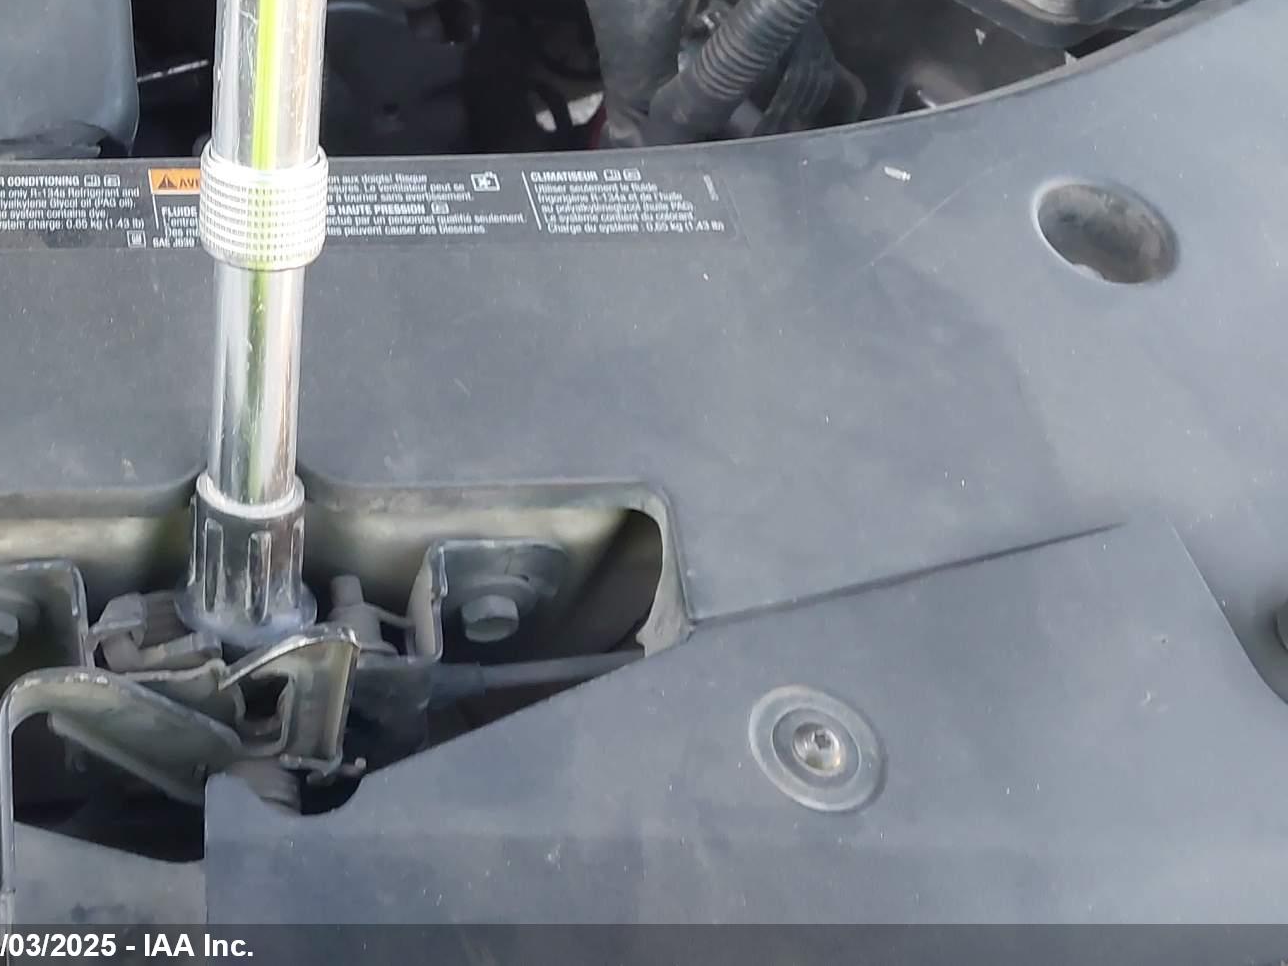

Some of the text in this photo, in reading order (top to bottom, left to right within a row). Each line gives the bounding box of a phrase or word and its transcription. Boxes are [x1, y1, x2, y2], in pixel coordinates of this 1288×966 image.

[7, 175, 80, 187] CONDITIONING
[530, 170, 599, 183] CLIMATISEUR
[8, 187, 27, 200] only
[68, 187, 120, 199] Refrigerant
[122, 186, 140, 198] and
[10, 208, 44, 220] system
[46, 208, 87, 219] contains
[161, 205, 198, 218] FLUIDE
[338, 204, 372, 216] HAUTE
[373, 203, 426, 215] PRESSION
[90, 218, 103, 230] kg
[132, 217, 145, 229] lb)
